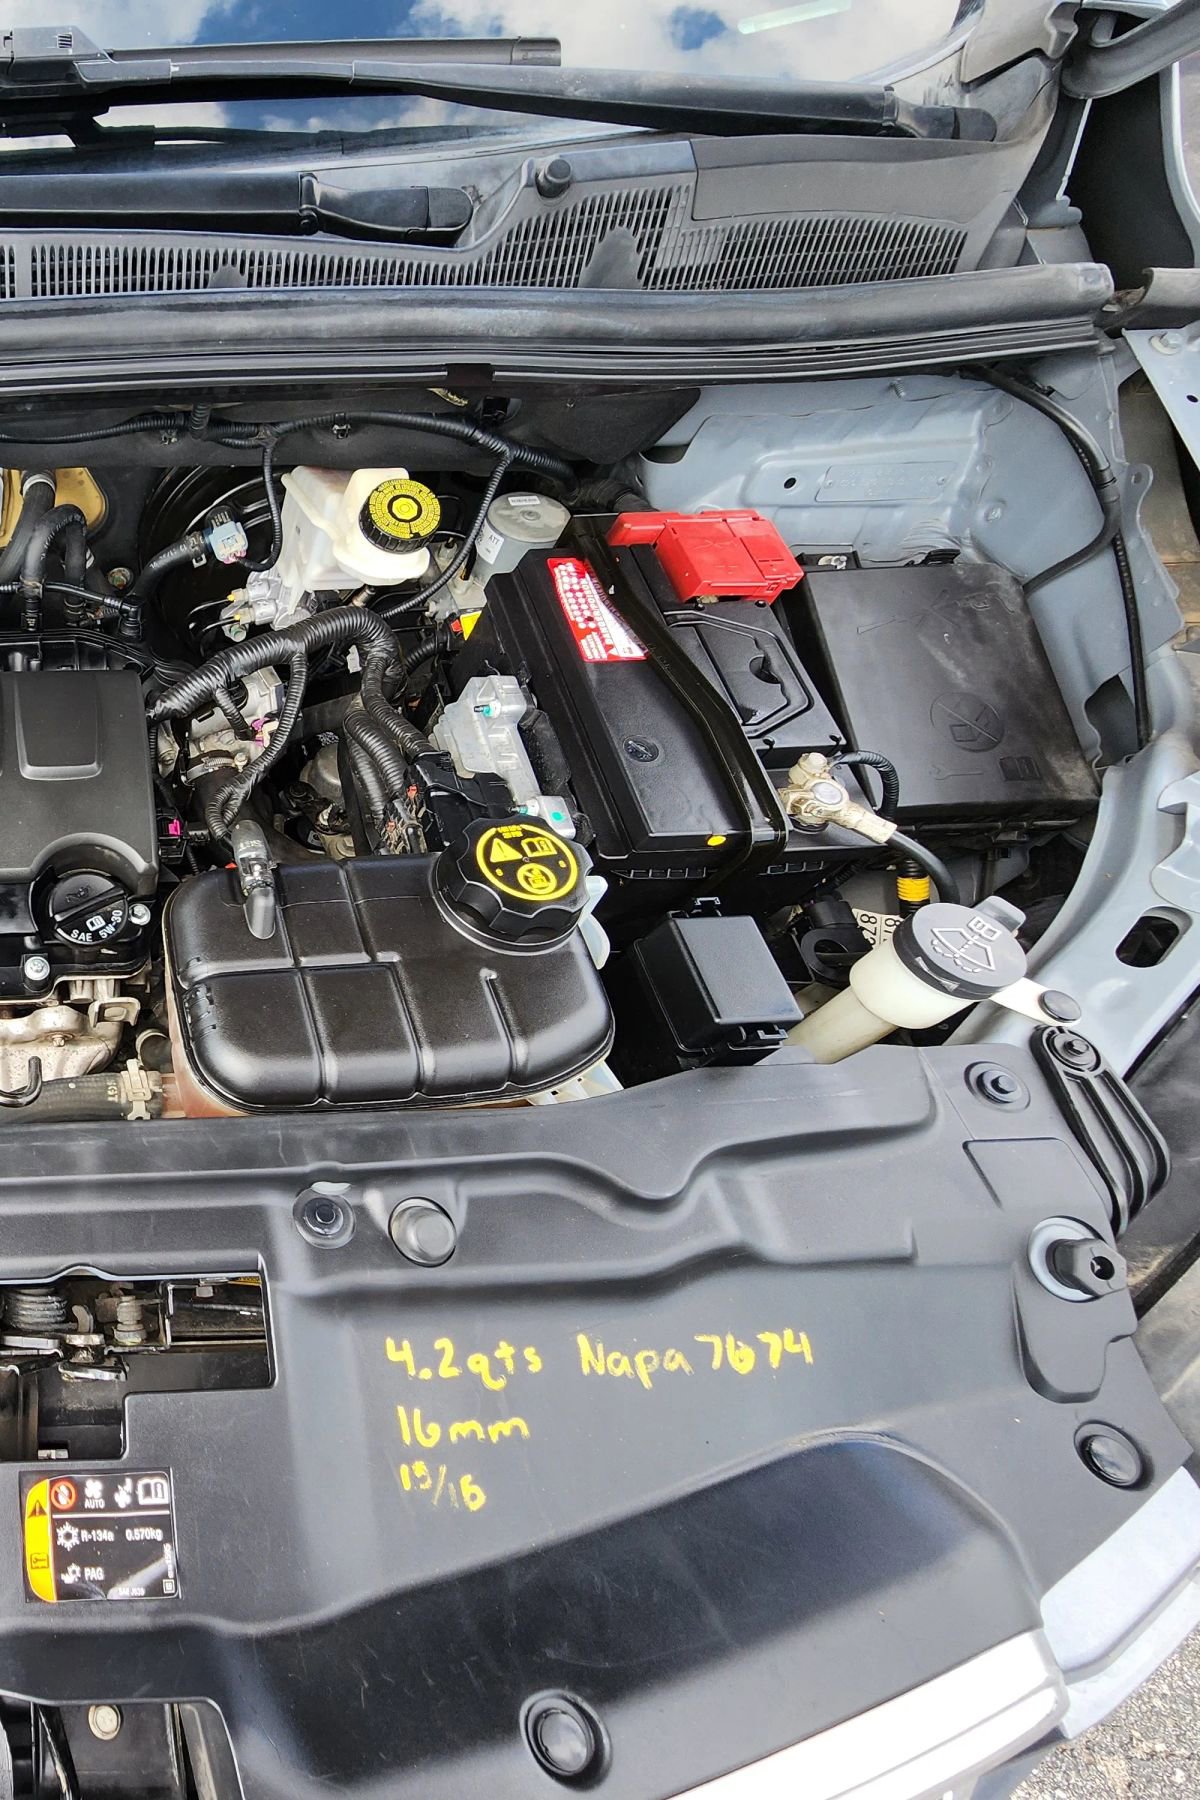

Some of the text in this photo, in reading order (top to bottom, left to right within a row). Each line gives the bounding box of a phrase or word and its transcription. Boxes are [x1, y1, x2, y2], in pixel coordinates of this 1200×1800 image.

[71, 909, 123, 942] SAE 5W-30
[576, 1333, 694, 1390] Napa
[694, 1328, 814, 1375] 7674
[84, 1499, 105, 1509] AUTO
[81, 1528, 163, 1542] R-134a 0.570kg
[84, 1567, 104, 1580] PAG
